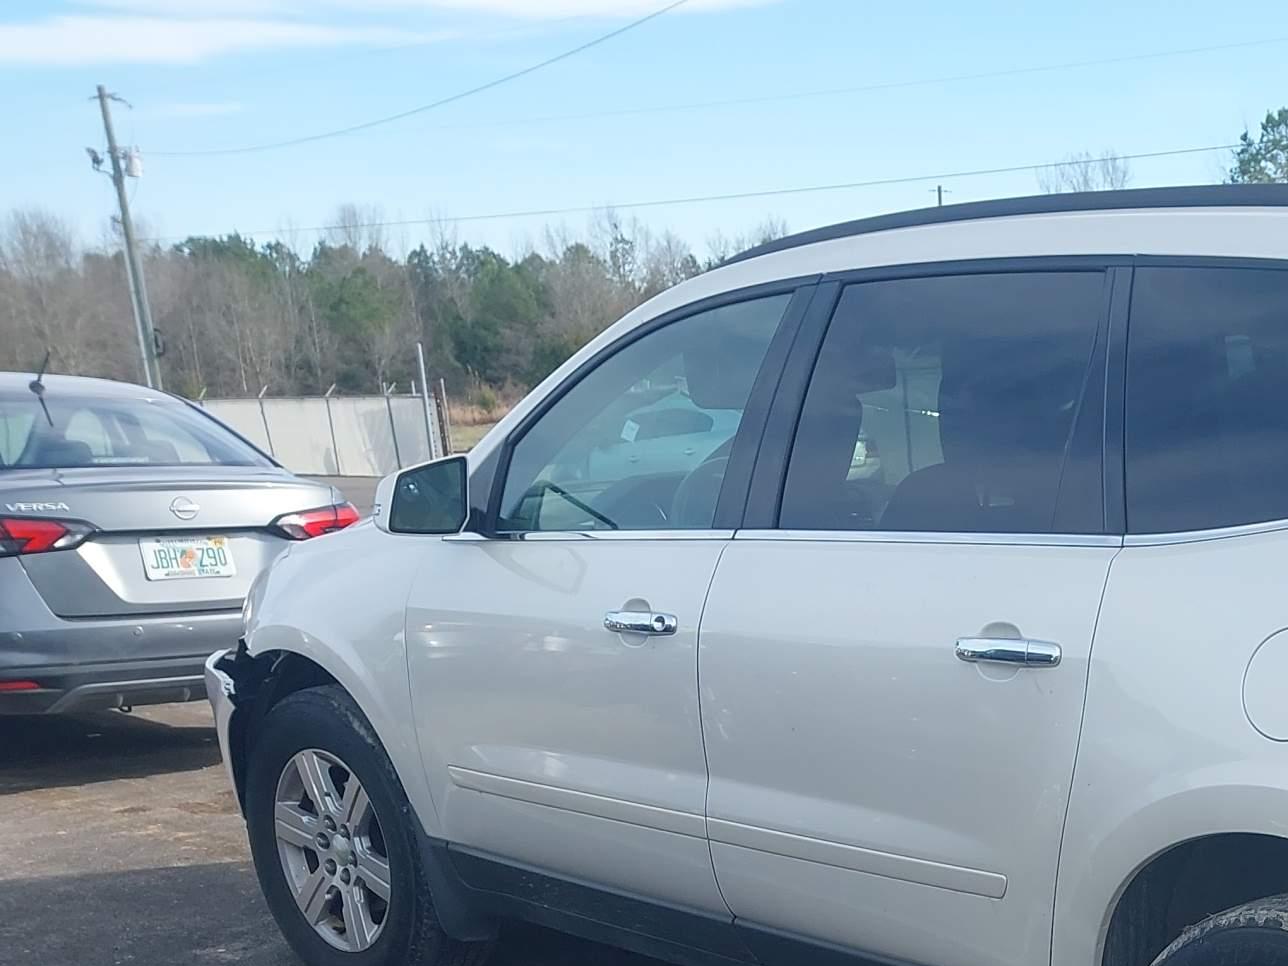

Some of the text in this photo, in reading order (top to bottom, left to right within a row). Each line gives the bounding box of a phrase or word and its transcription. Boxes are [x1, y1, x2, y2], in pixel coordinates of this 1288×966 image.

[4, 502, 70, 512] VERSA
[151, 546, 228, 569] JBH Z90
